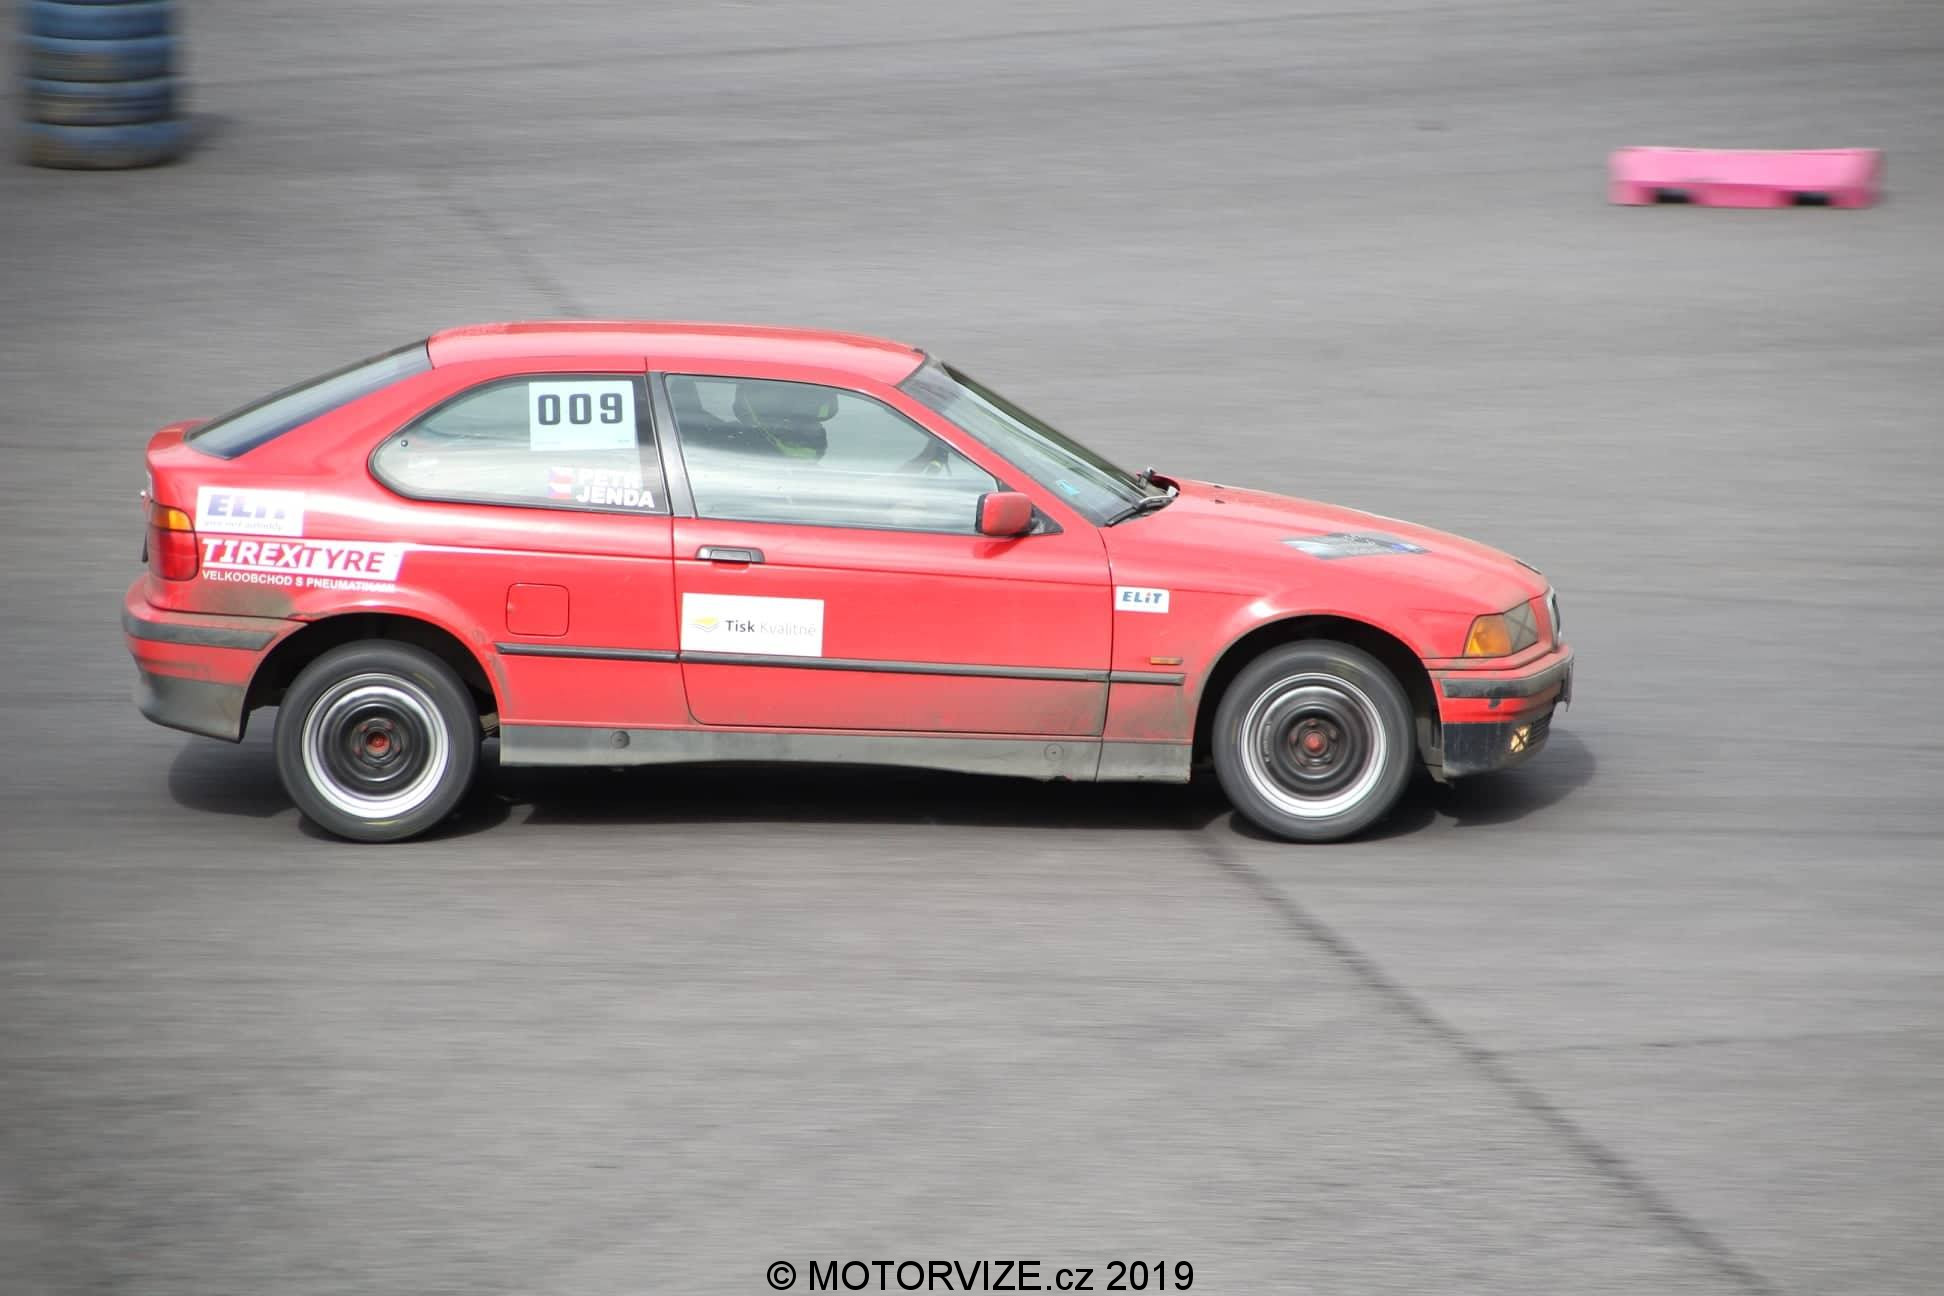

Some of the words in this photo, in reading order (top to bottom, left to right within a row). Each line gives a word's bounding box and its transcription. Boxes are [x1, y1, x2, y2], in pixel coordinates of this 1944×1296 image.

[538, 393, 623, 426] 009
[576, 486, 655, 508] JENDA
[202, 538, 386, 574] TIREXTYRE
[202, 570, 292, 586] VELKOOBCHOD
[295, 576, 304, 587] S
[307, 577, 396, 593] PNEUMATI
[725, 619, 755, 633] Tisk
